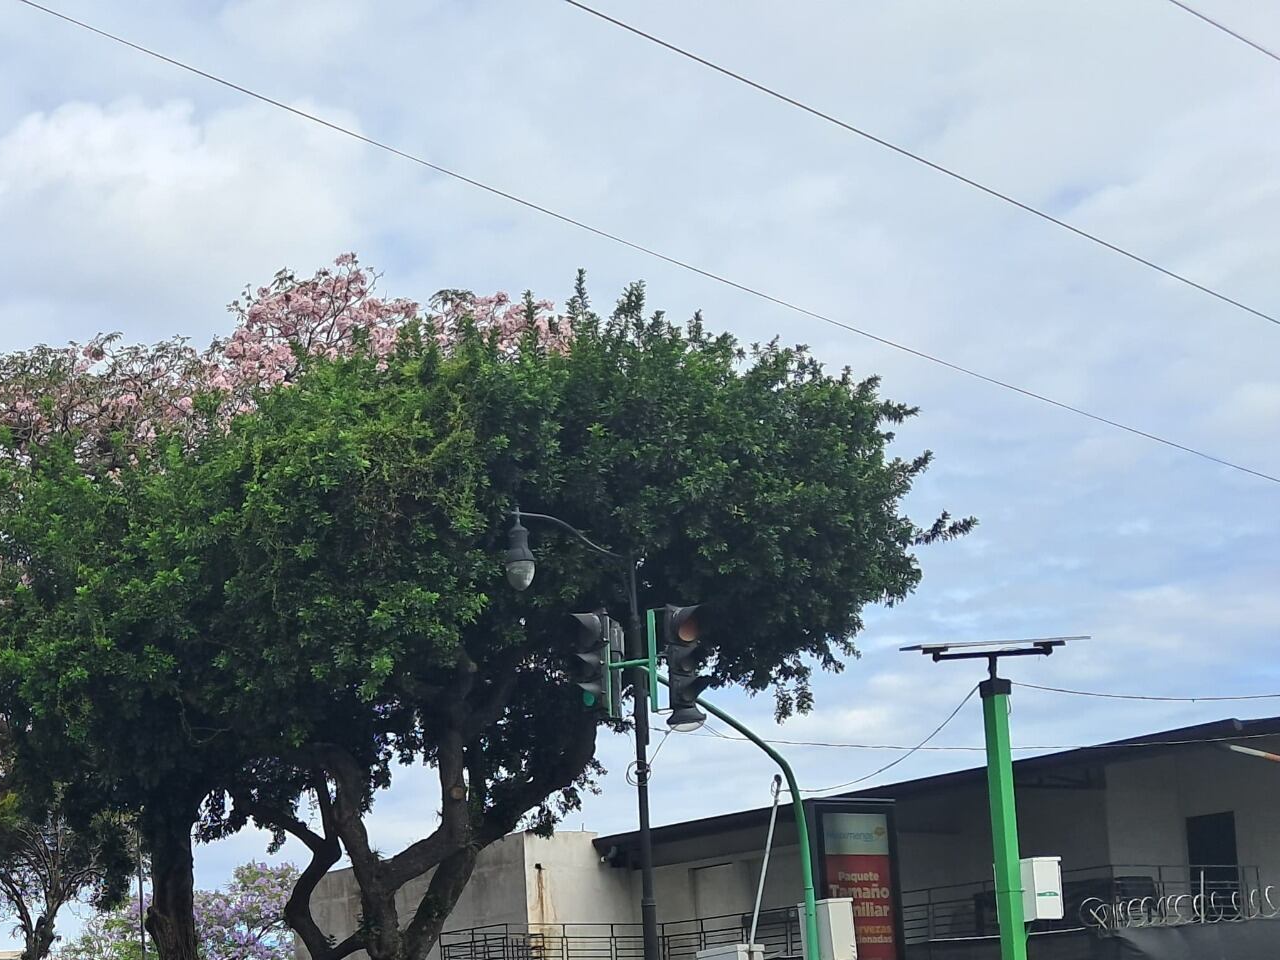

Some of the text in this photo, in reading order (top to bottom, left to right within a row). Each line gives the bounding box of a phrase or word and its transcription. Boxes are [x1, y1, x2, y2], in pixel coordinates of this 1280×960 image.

[838, 872, 880, 883] Paquete
[829, 884, 890, 899] Tamaño
[854, 902, 890, 917] miliar
[857, 925, 891, 934] rvezas
[859, 935, 892, 944] ionadas
